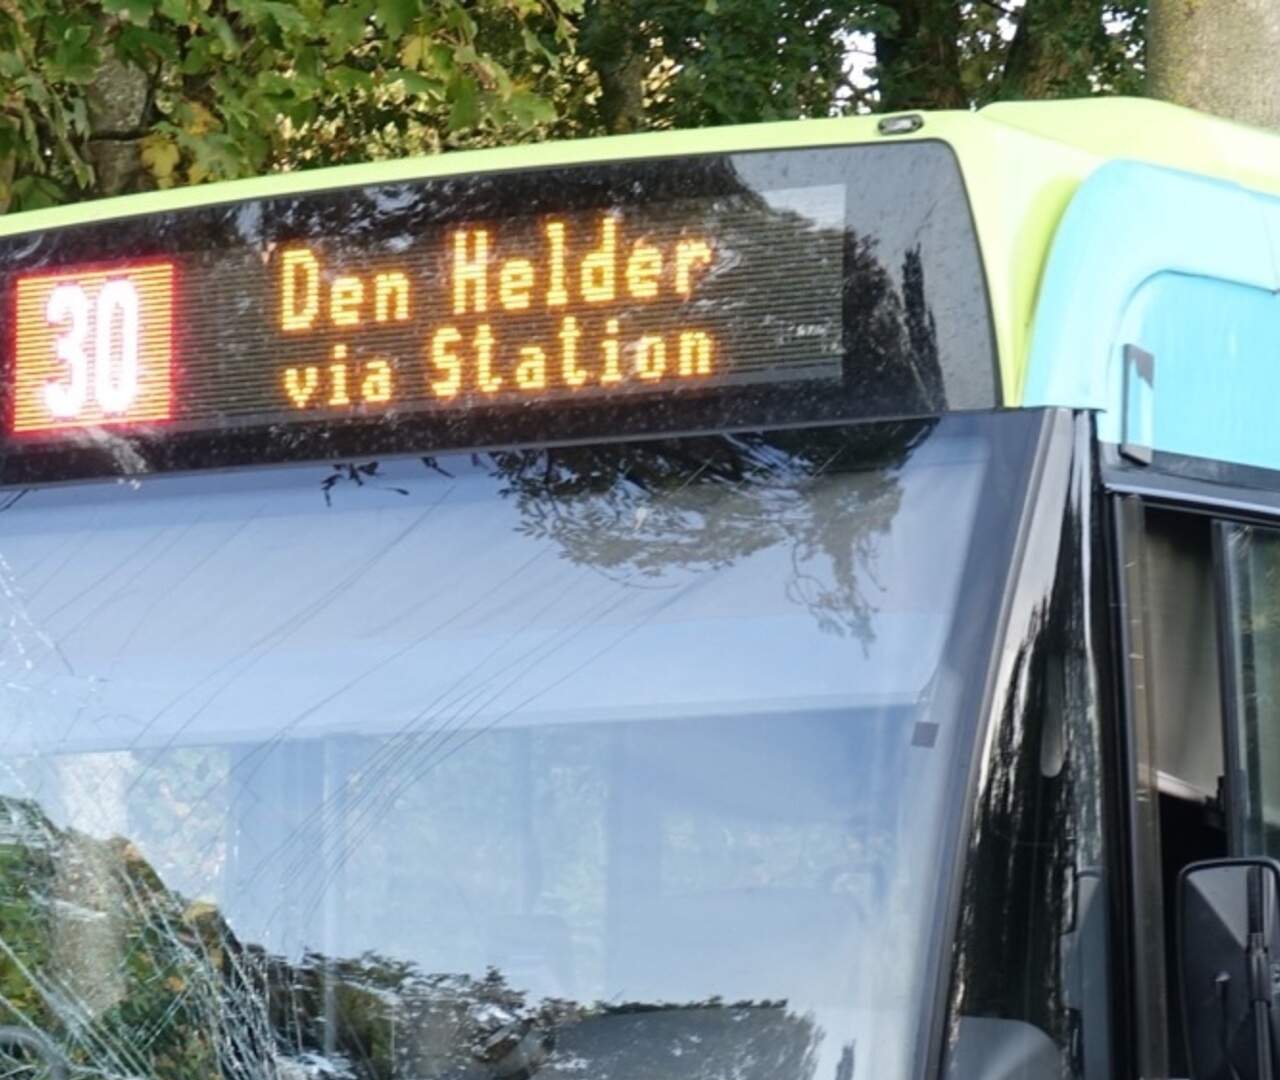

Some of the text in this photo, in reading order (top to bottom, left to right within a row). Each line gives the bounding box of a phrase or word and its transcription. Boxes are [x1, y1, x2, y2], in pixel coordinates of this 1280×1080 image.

[279, 213, 714, 332] Den Helder
[42, 277, 144, 418] 30
[283, 314, 716, 409] via Station
